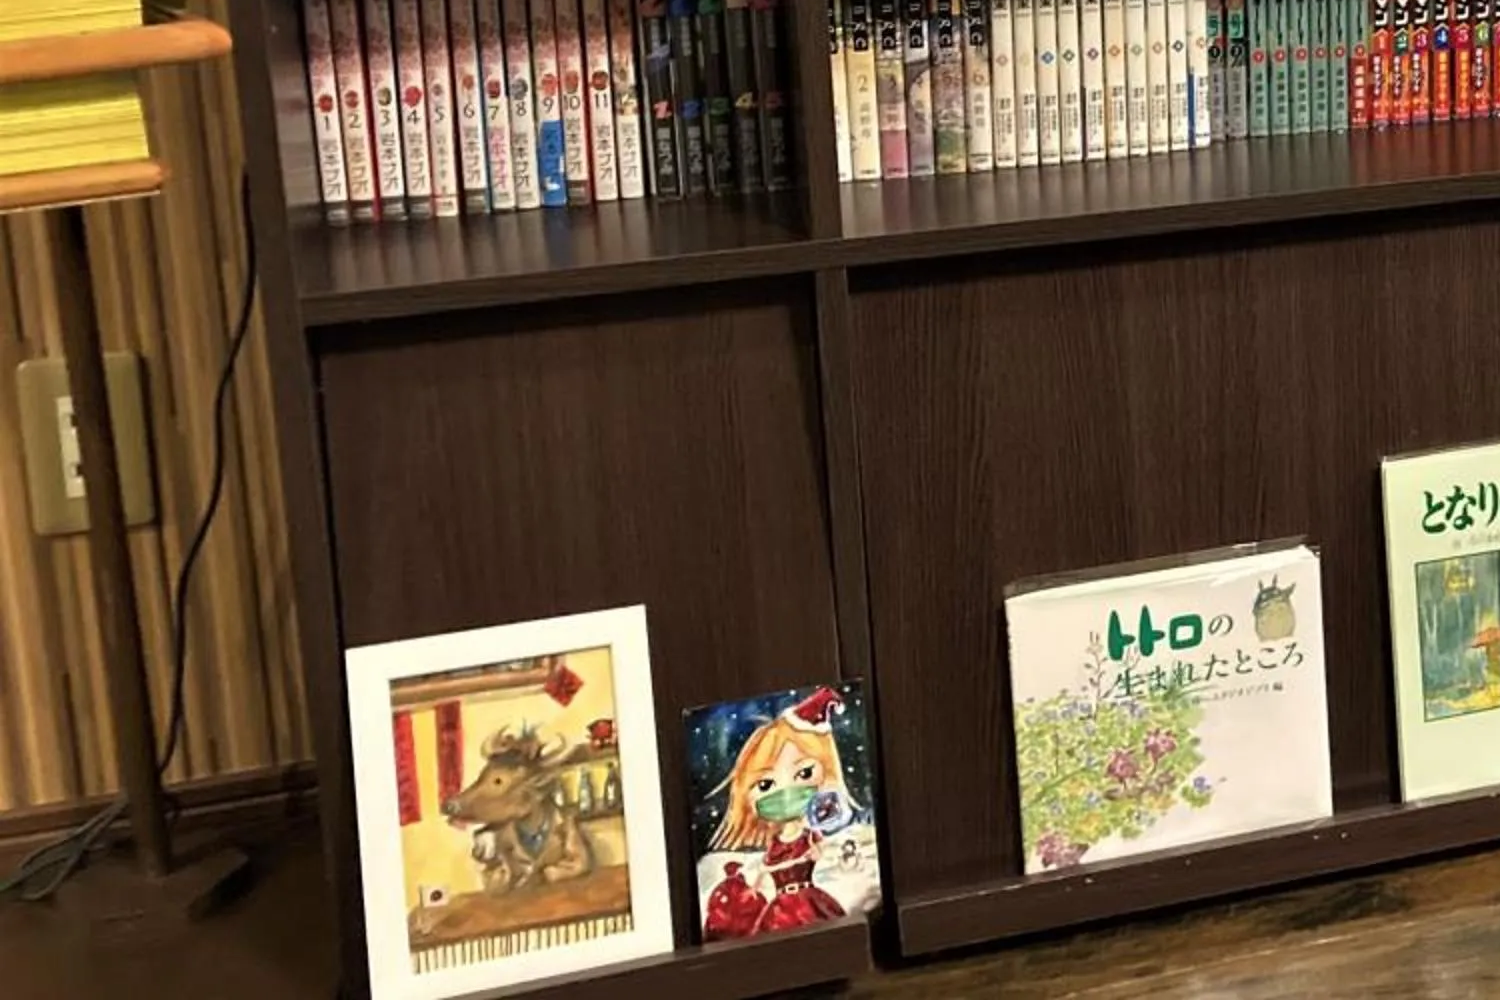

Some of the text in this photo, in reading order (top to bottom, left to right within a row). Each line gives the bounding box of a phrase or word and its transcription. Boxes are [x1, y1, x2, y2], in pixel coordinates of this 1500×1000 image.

[515, 101, 527, 116] 8
[543, 98, 554, 113] 9
[563, 96, 580, 110] 10
[594, 94, 608, 108] 11
[380, 110, 391, 126] 3
[407, 110, 420, 124] 4
[435, 106, 444, 121] 5
[463, 104, 475, 119] 6
[488, 105, 500, 121] 7
[324, 116, 330, 130] 1
[349, 113, 362, 128] 2
[1107, 604, 1235, 662] トトロの
[1111, 642, 1304, 699] 生まれたところ
